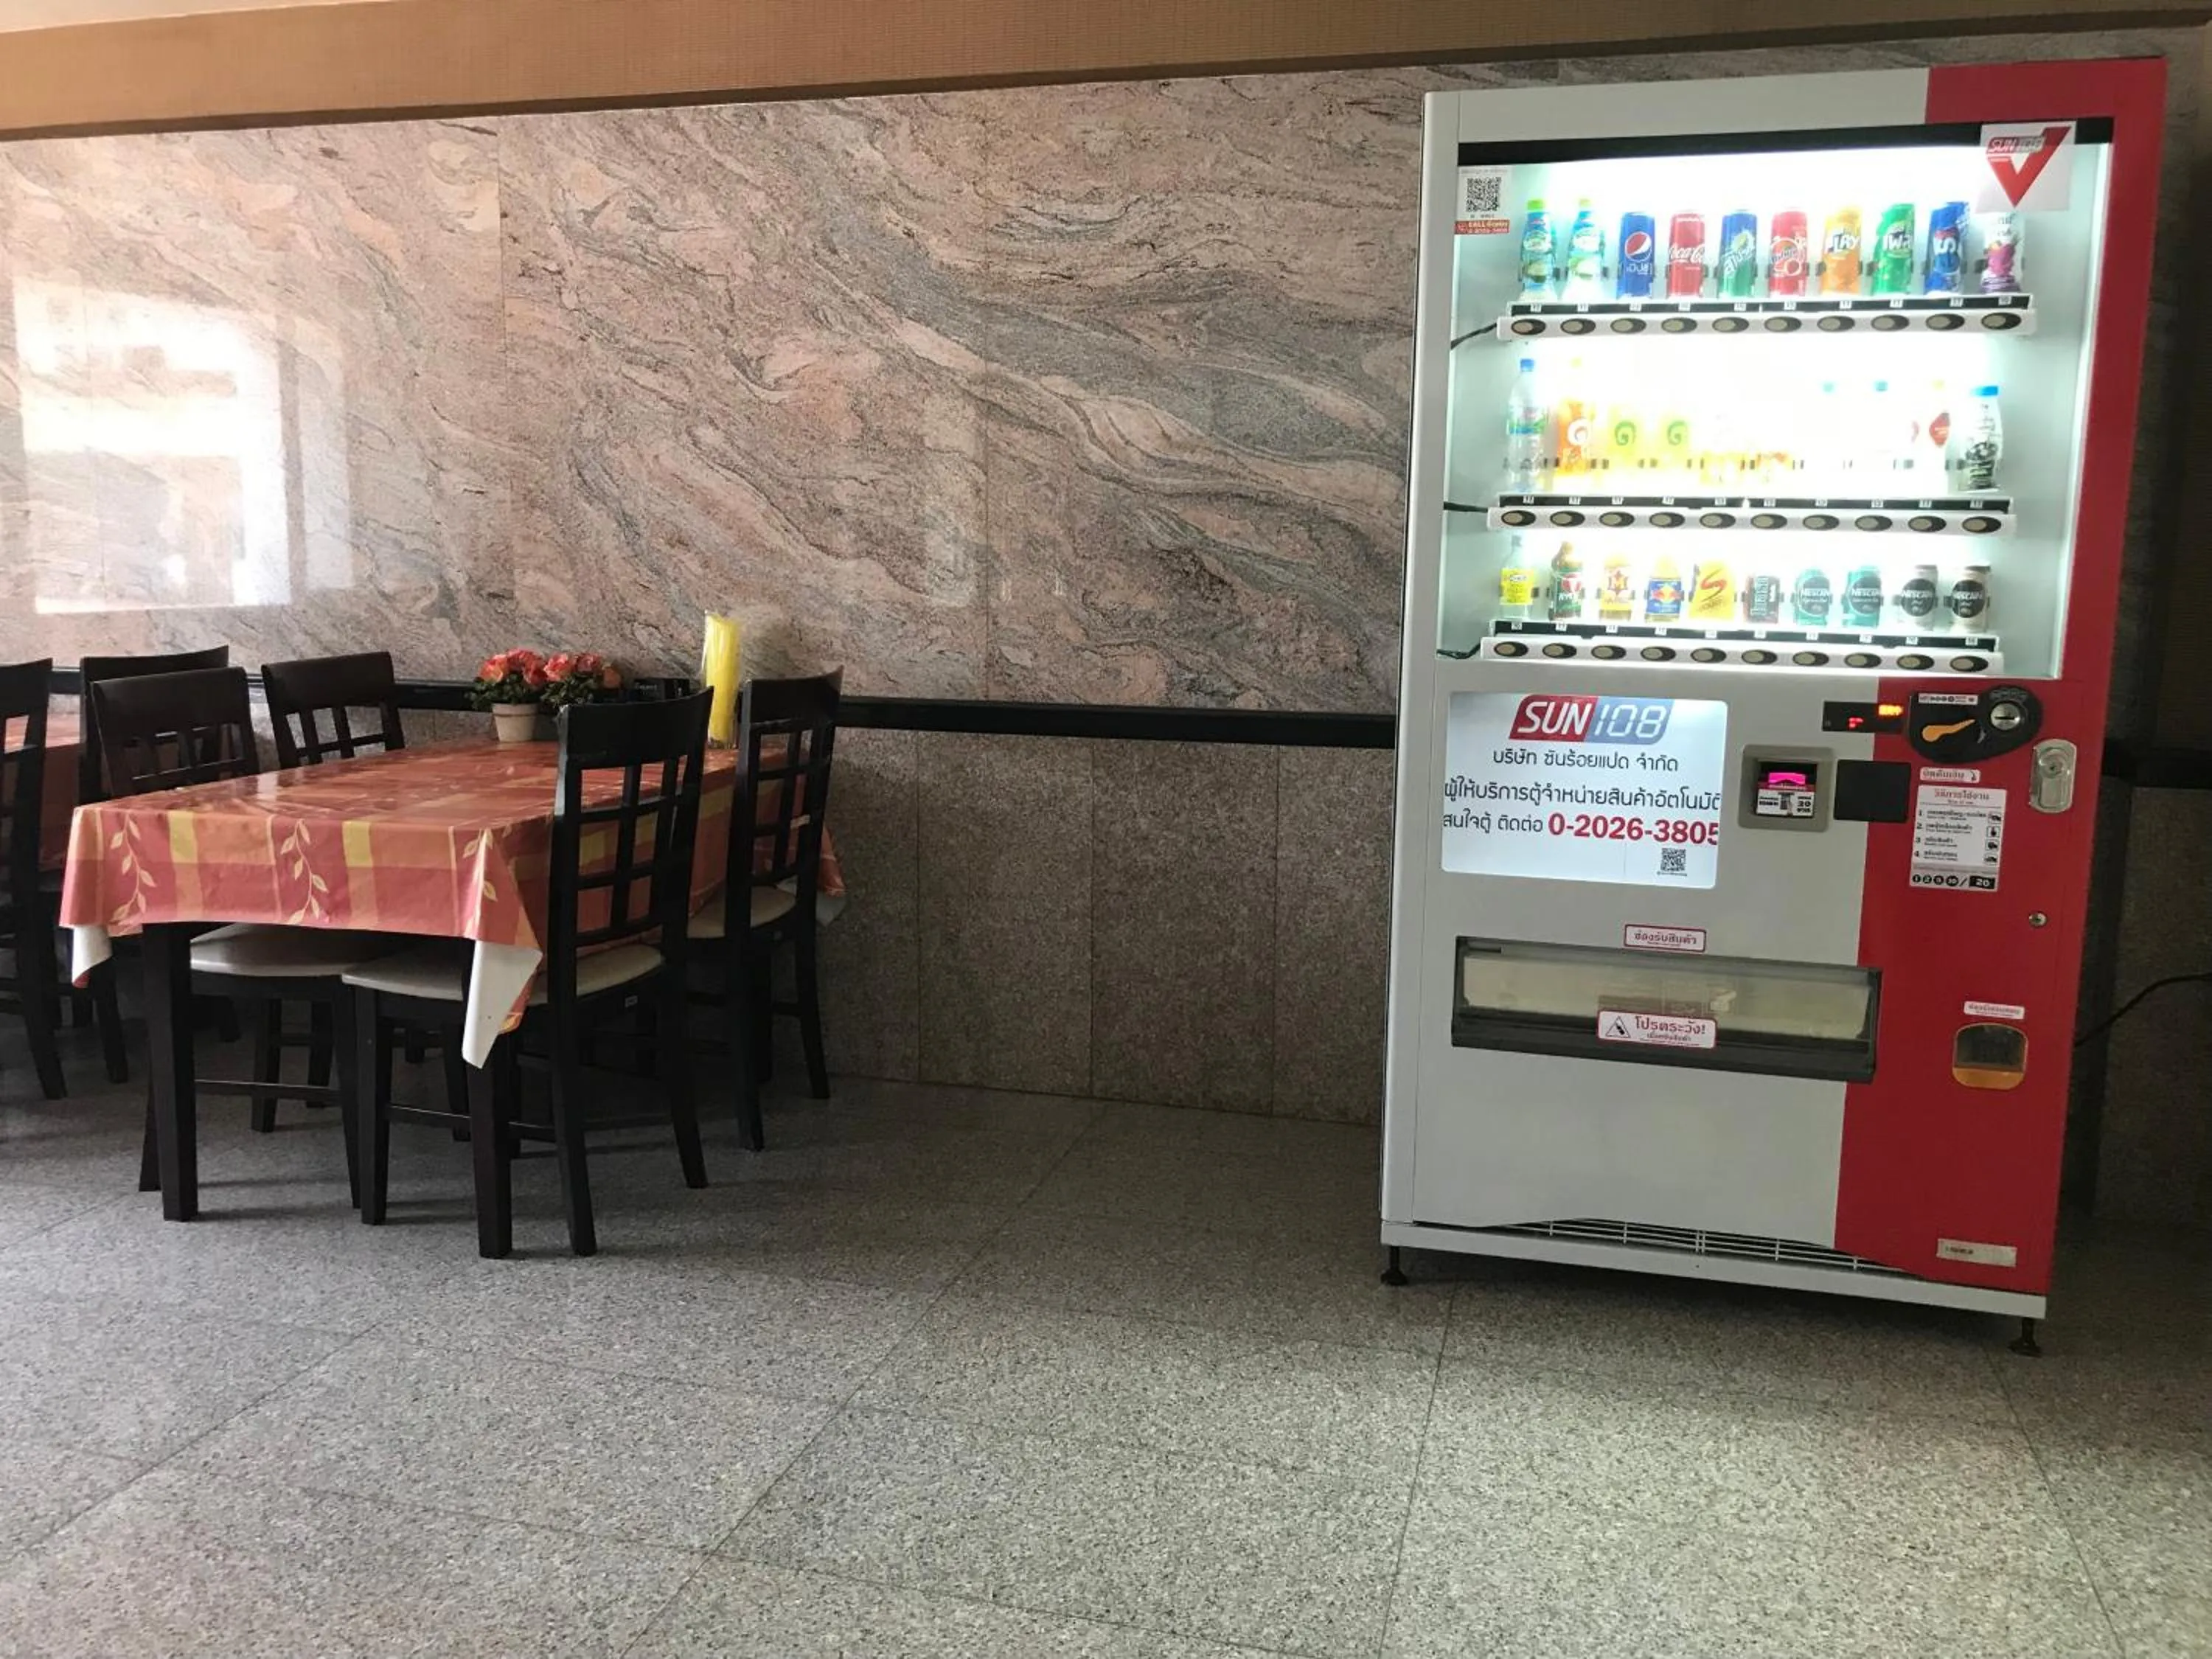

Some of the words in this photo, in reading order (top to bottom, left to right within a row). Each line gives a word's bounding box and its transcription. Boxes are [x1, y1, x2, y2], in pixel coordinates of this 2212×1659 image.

[1517, 701, 1593, 735] SUN
[1593, 703, 1667, 738] 108
[1493, 748, 1537, 765] บริษัท
[1544, 748, 1629, 770] ซันร้อยแปด
[1636, 752, 1679, 772] จำกัด
[1443, 808, 1492, 834] สนใจตู้
[1498, 815, 1543, 833] ติดต่อ
[1635, 1015, 1705, 1034] โปรดระวัง!
